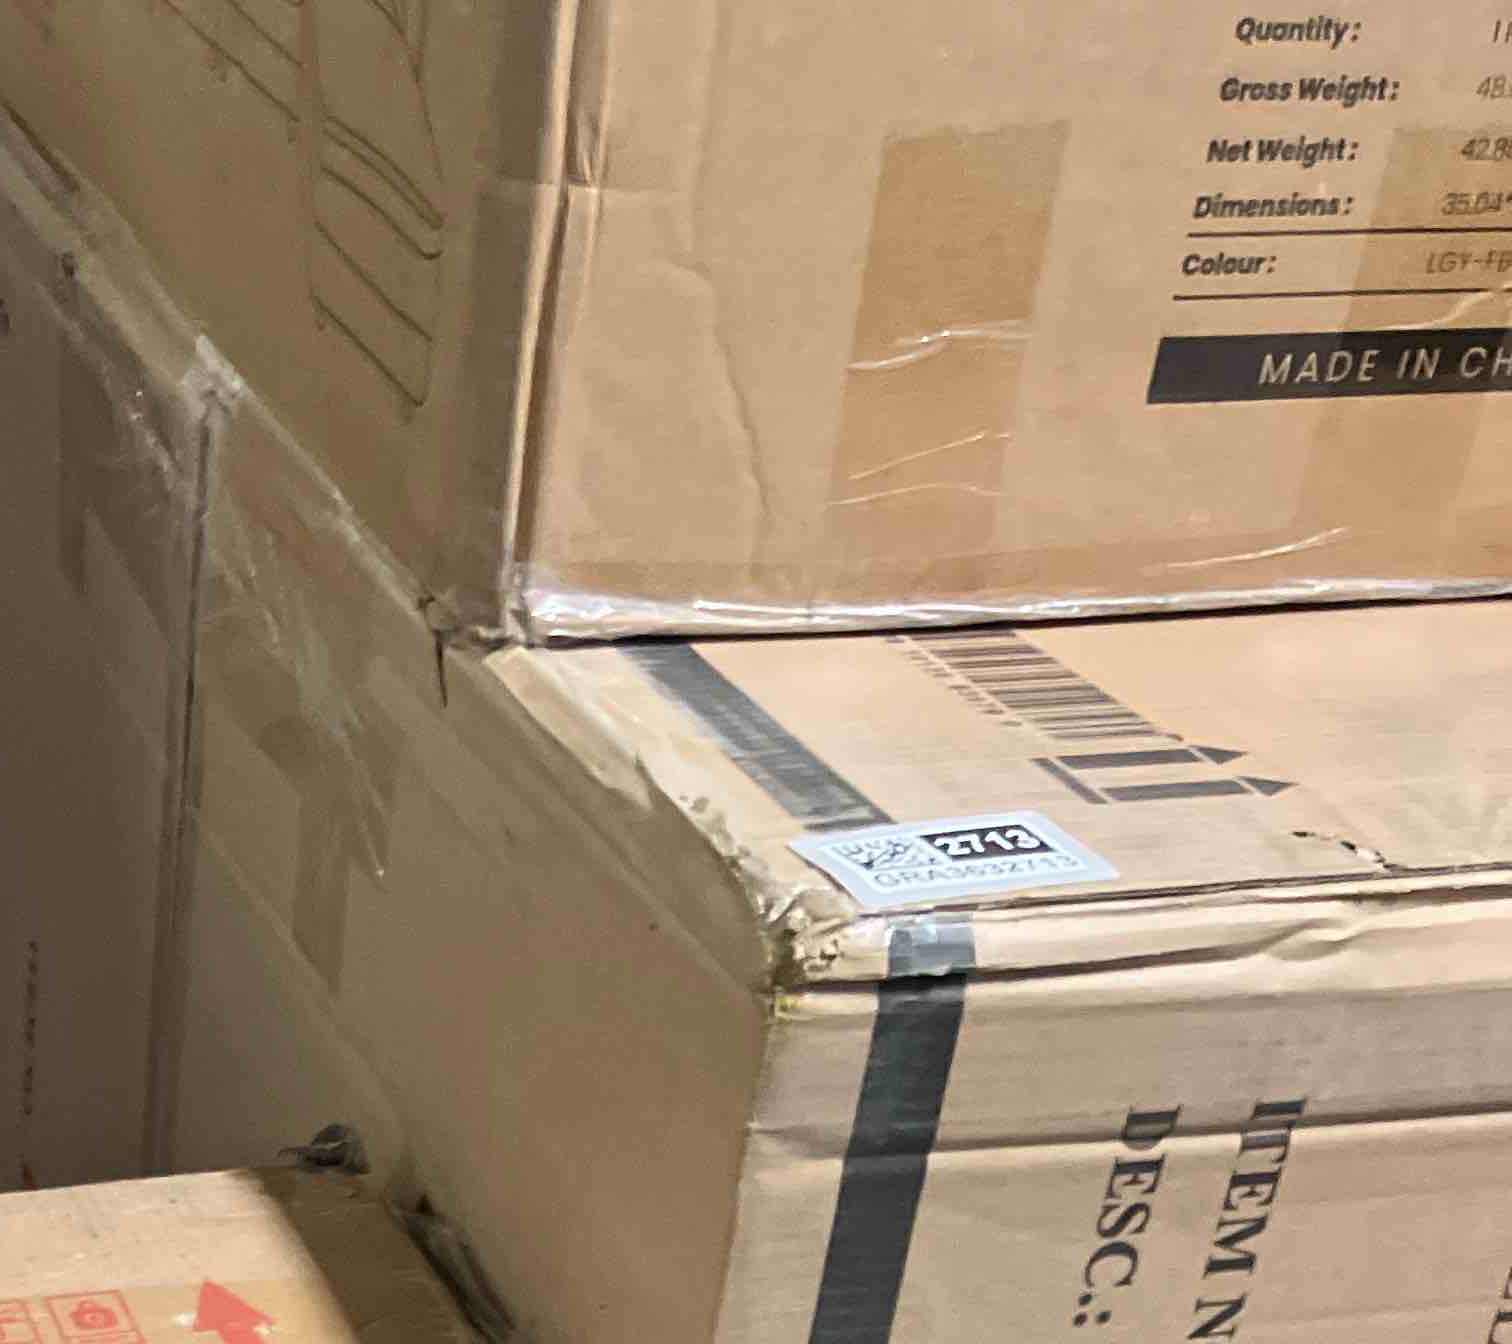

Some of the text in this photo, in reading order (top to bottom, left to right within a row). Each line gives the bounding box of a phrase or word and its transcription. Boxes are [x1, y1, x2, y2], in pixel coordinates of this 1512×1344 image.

[1236, 15, 1361, 49] Quantity:
[1220, 77, 1291, 102] Gross
[1299, 75, 1400, 108] Weight:
[1206, 139, 1250, 163] Net
[1257, 135, 1359, 169] Weight:
[1192, 193, 1355, 219] Dimensions:
[1181, 253, 1278, 276] Colour:
[1259, 346, 1512, 385] MADE IN CH
[933, 829, 1041, 857] 2713
[1203, 1097, 1308, 1278] ITEM
[1072, 1104, 1181, 1328] DESC.:
